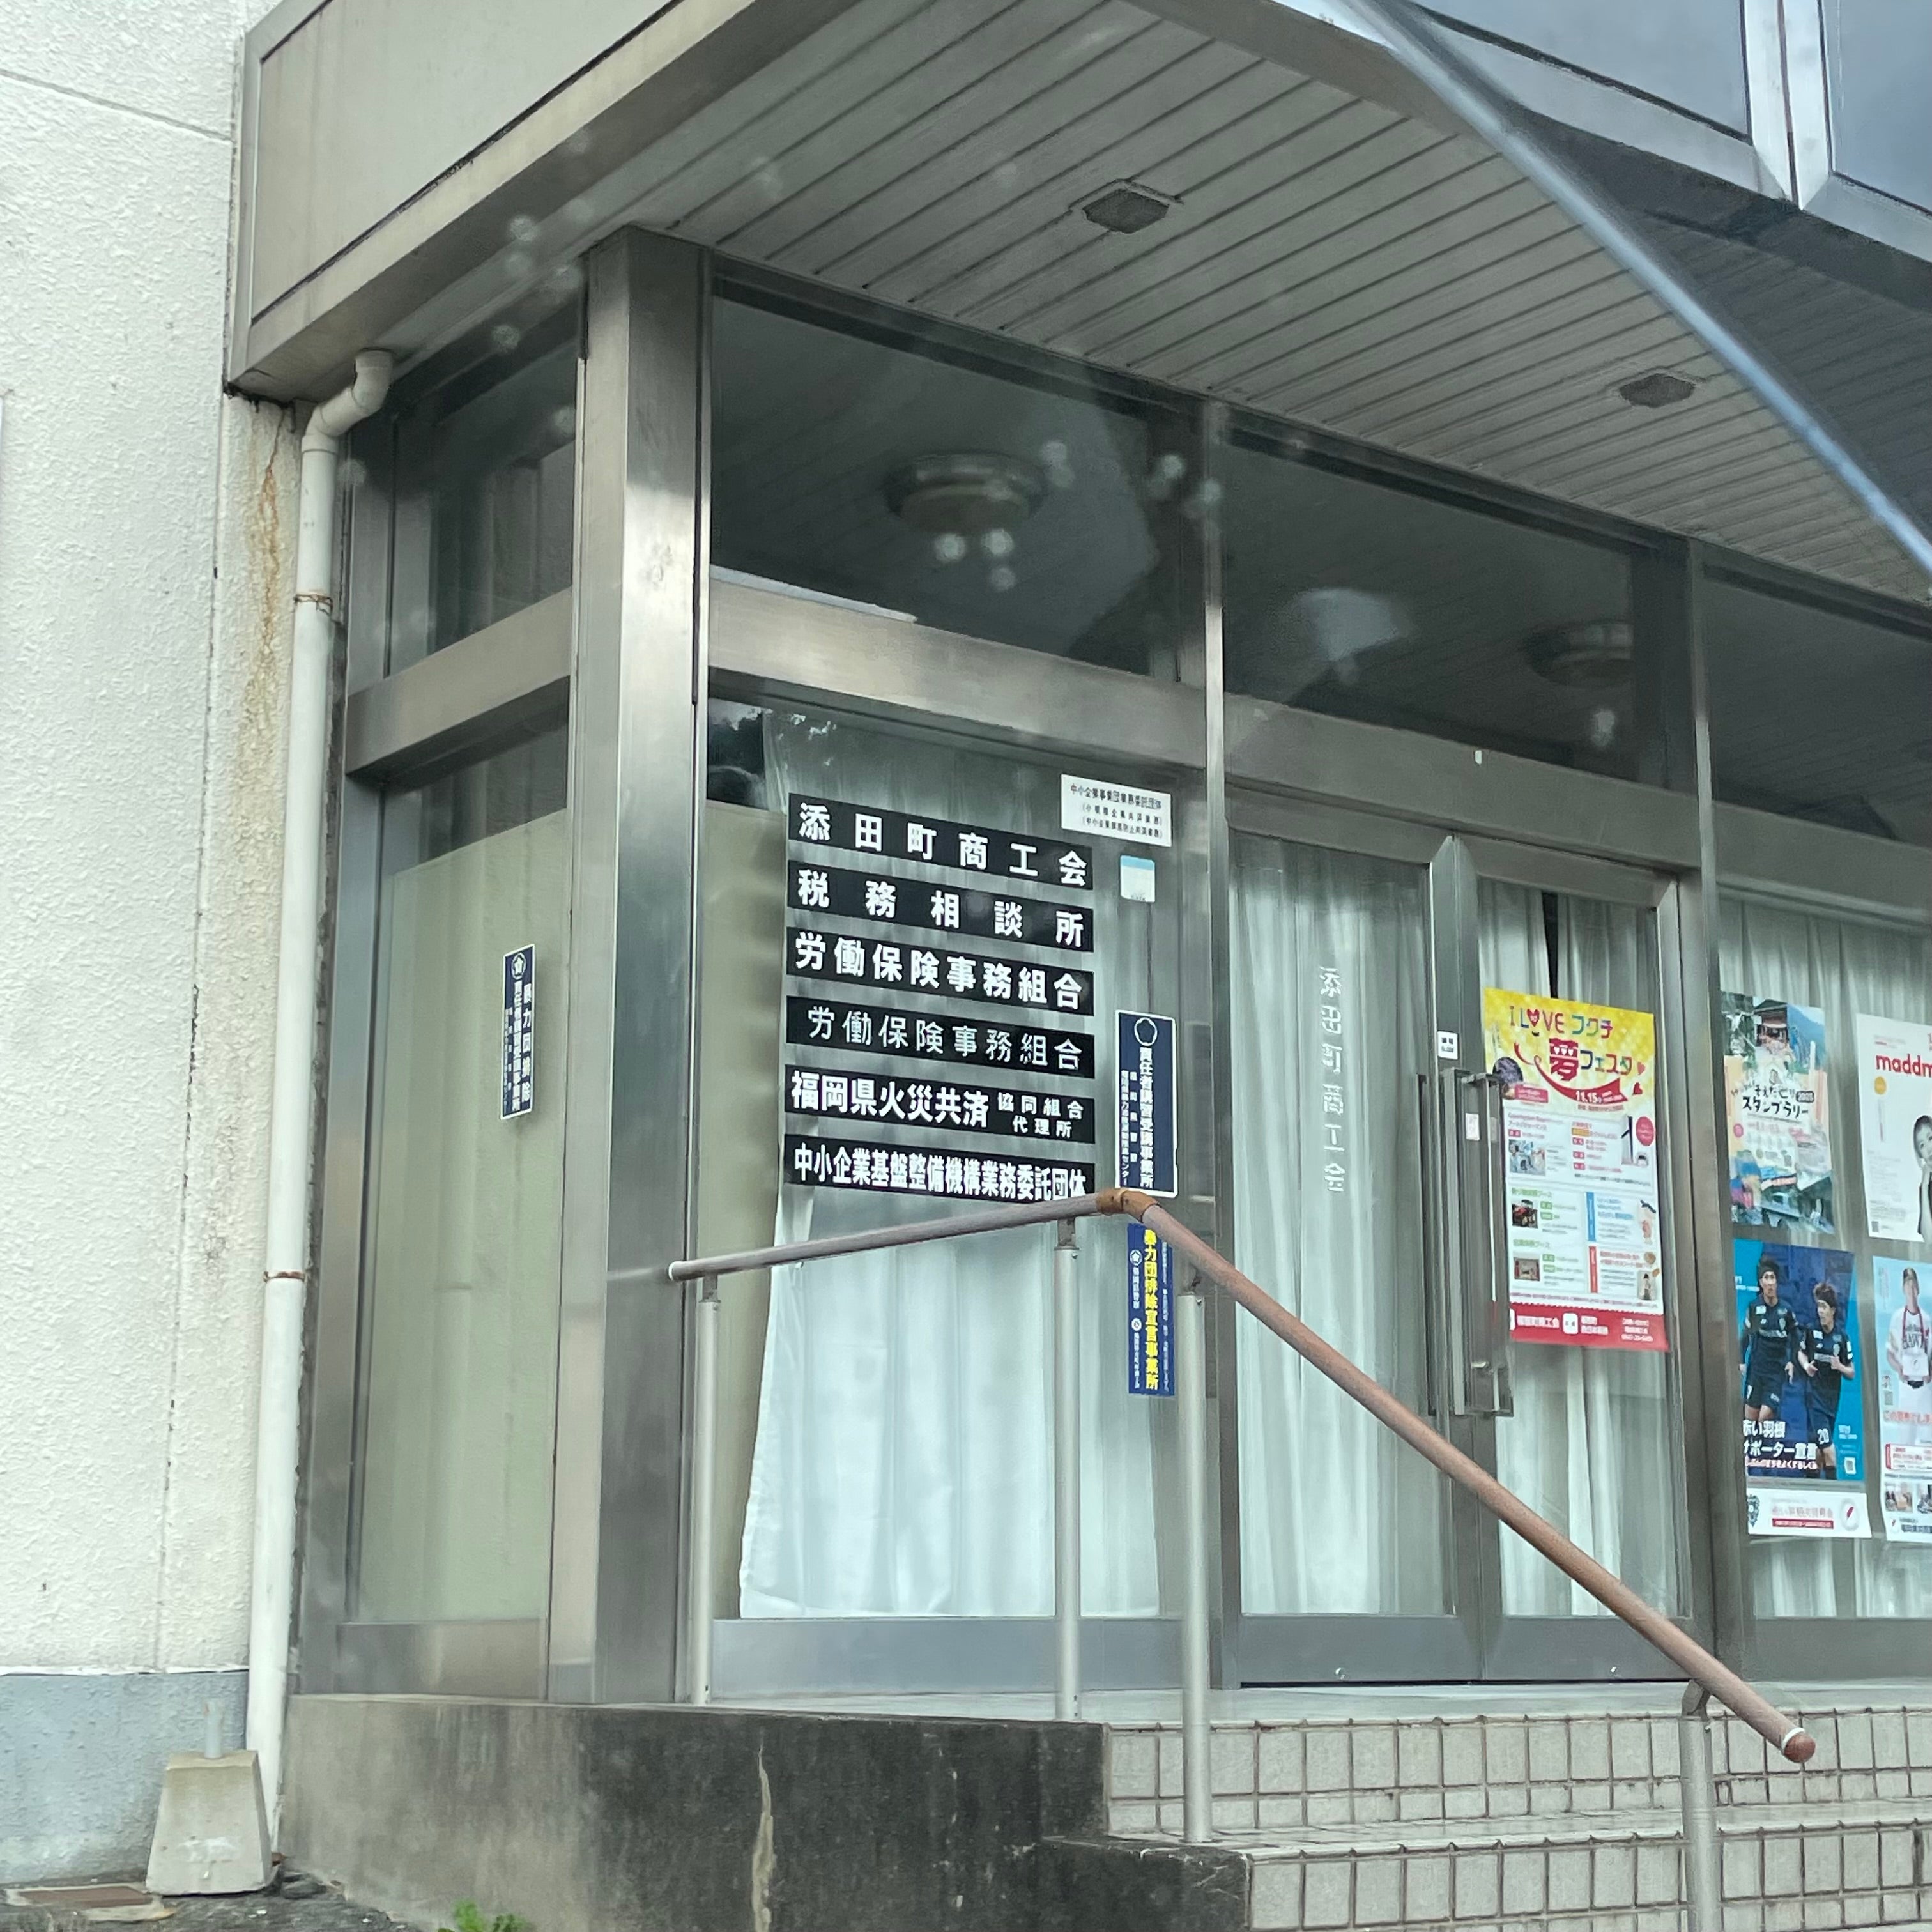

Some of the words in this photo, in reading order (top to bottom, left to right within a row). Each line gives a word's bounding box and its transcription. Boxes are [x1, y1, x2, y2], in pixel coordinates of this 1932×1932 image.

[799, 802, 1087, 887] 添田町商工会
[797, 869, 1084, 948] 税務相談所
[795, 931, 1083, 1010] 労働保険事務組合
[808, 1005, 1082, 1071] 労働保険事務組合
[1571, 1013, 1614, 1039] フクチ
[791, 1070, 990, 1128] 福岡県火災共済
[997, 1091, 1084, 1121] 協同組合
[1012, 1114, 1072, 1138] 代理所
[1742, 1095, 1809, 1119] スタンプラリー
[793, 1142, 1087, 1202] 中小企業基盤整備機構業務委託団体
